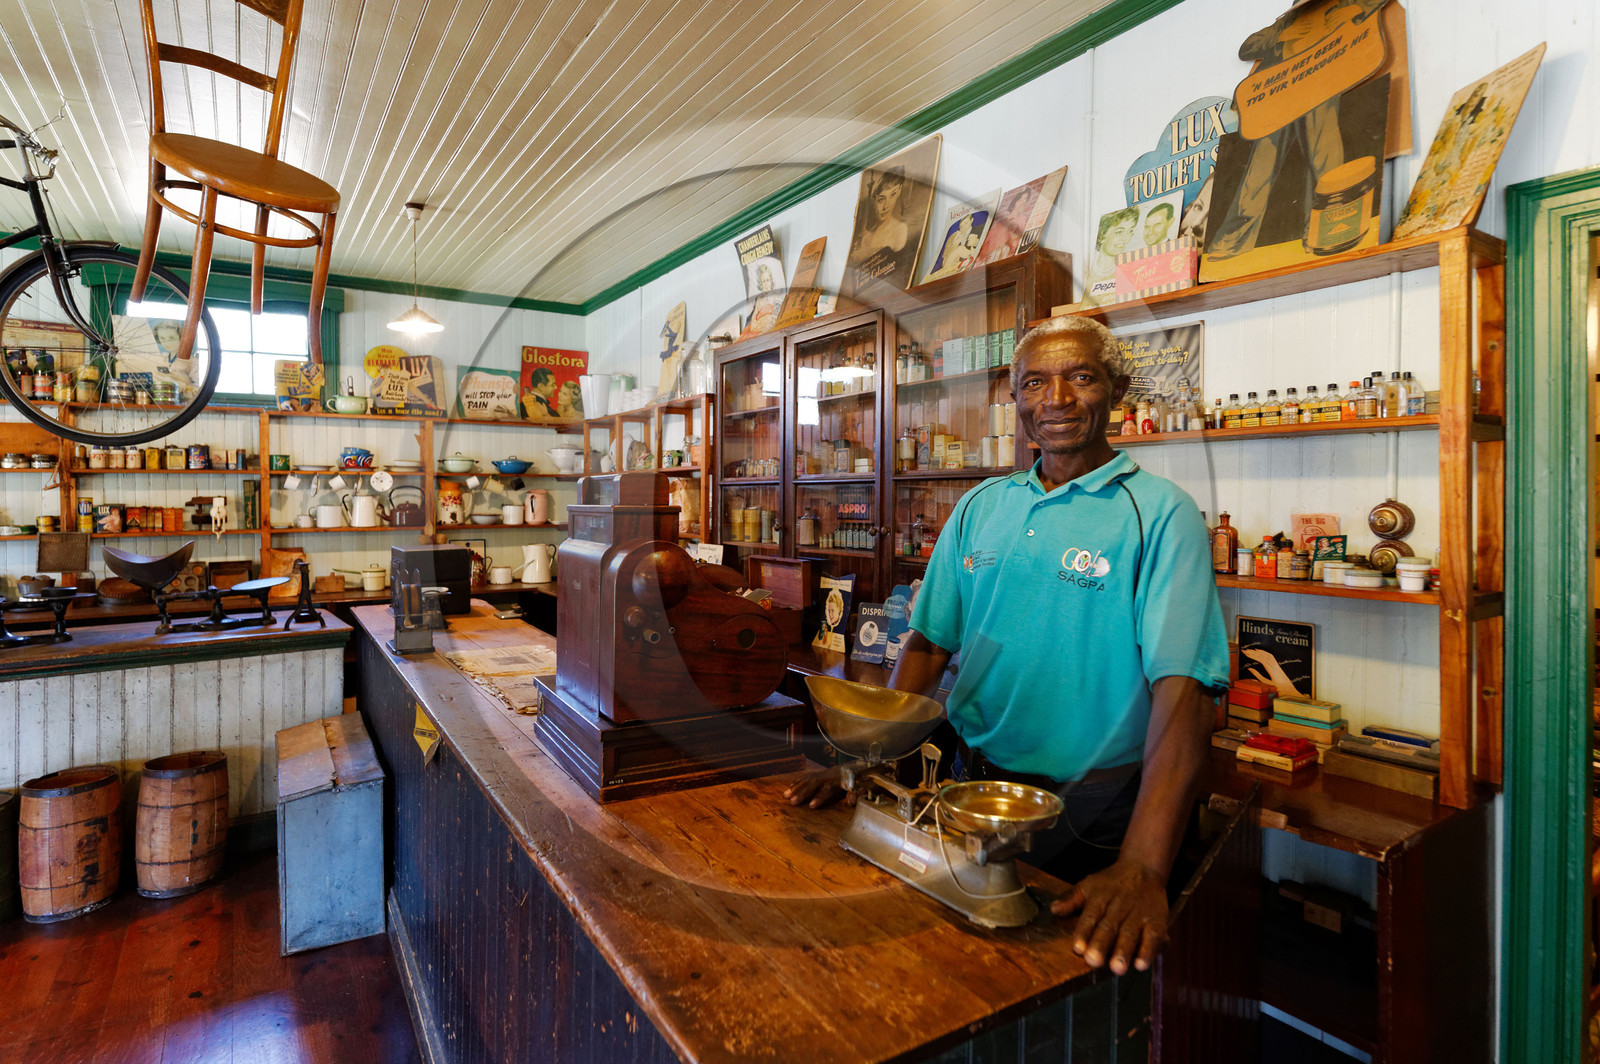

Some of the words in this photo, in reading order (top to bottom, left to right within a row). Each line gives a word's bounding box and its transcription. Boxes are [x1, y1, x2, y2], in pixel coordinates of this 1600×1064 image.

[1264, 68, 1289, 87] MAN
[1291, 55, 1312, 73] HET
[1314, 35, 1343, 59] GEEN
[1246, 93, 1266, 108] TYD
[1270, 81, 1288, 96] VIR
[1291, 44, 1348, 85] VERKOUES
[1350, 28, 1370, 49] NIE
[1170, 99, 1228, 156] LUX
[1129, 150, 1206, 204] TOILET
[1118, 341, 1133, 351] Did
[1134, 341, 1150, 350] you
[522, 347, 586, 369] Glostora
[1124, 349, 1160, 361] Maclean
[1160, 345, 1182, 357] your
[401, 356, 432, 377] LUX
[388, 384, 404, 392] LUX
[465, 391, 478, 399] will
[479, 391, 496, 399] STOP
[496, 393, 512, 401] your
[467, 400, 489, 410] PAIN
[78, 502, 93, 513] VIM
[98, 506, 110, 514] LUX
[838, 503, 867, 514] ASPRO
[1301, 517, 1313, 525] THE
[1315, 517, 1326, 525] BIG
[1056, 570, 1105, 593] SAGPA
[1242, 621, 1275, 635] Hinds
[1275, 635, 1309, 647] cream
